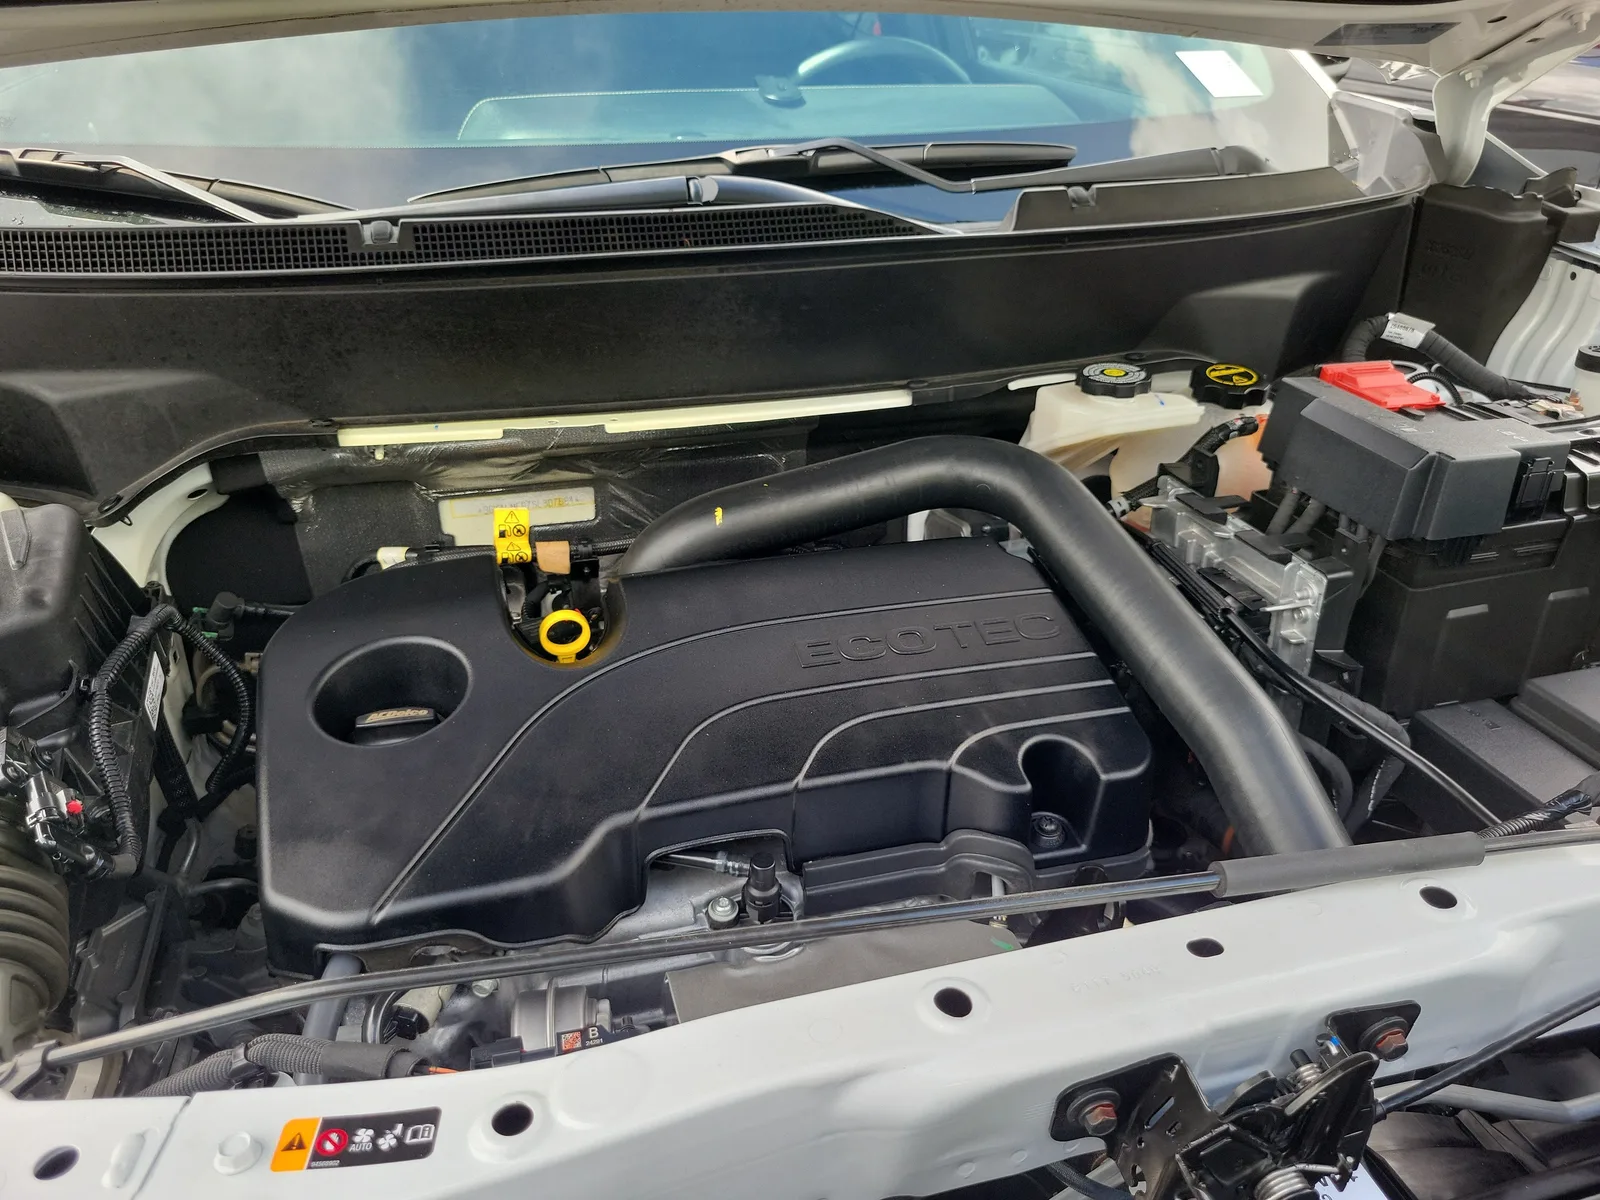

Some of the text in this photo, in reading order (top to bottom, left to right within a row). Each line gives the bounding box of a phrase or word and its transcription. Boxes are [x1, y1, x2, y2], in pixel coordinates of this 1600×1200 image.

[795, 612, 1060, 669] ECOTEC
[364, 708, 429, 724] ACDelco
[589, 1026, 599, 1039] B
[349, 1142, 373, 1152] AUTO
